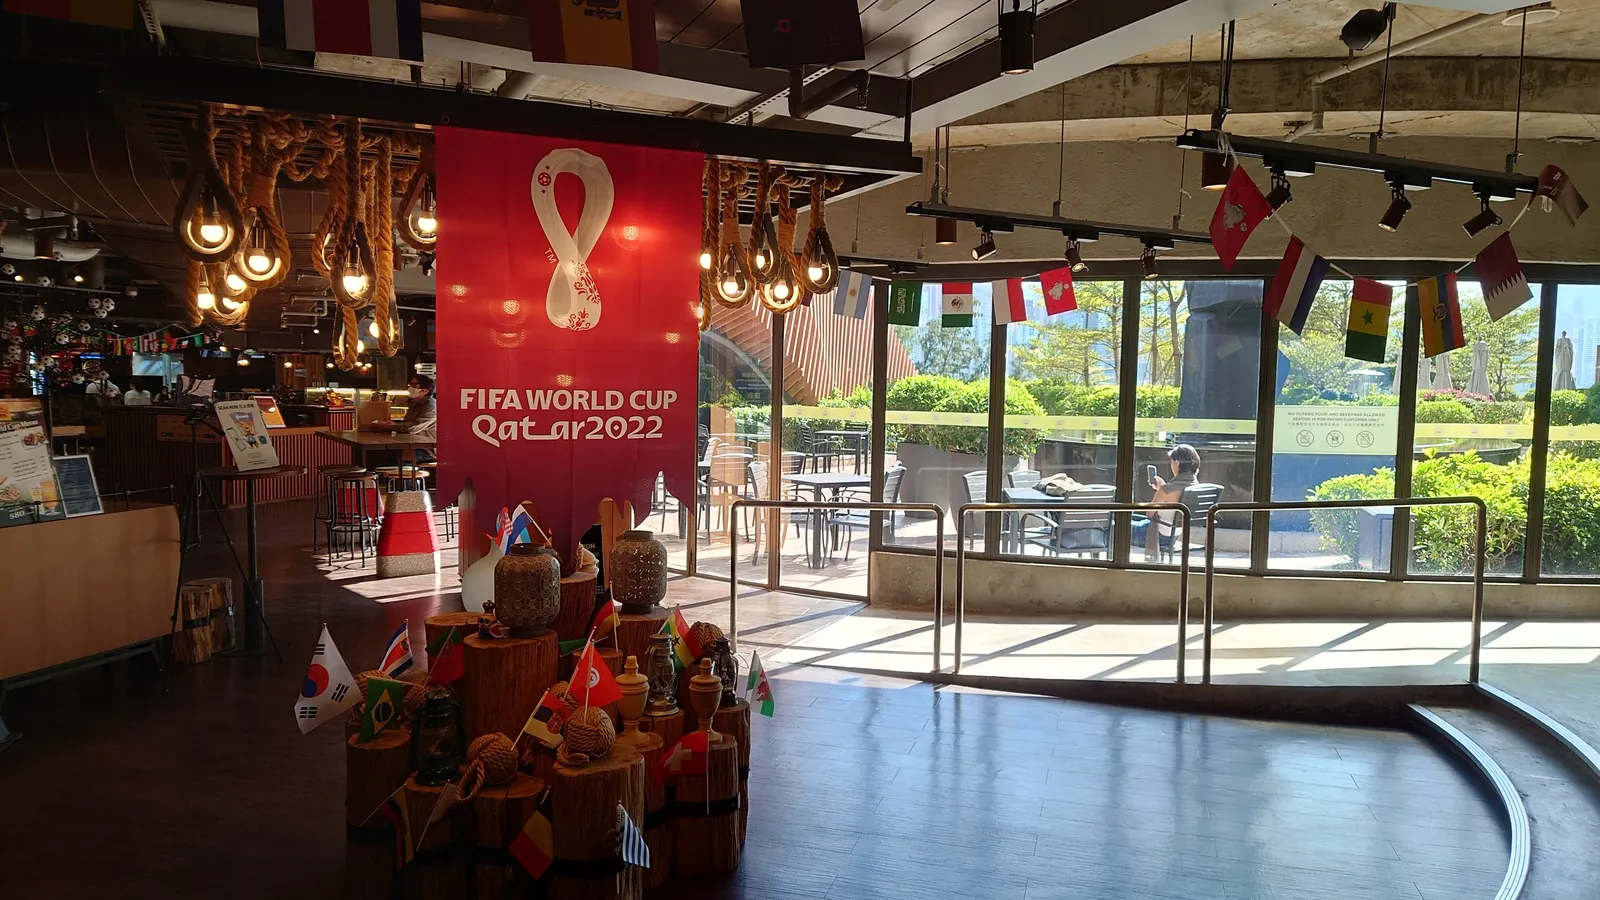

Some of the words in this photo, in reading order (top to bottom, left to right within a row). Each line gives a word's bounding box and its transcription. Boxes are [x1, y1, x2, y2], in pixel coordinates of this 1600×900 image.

[544, 247, 557, 264] TM
[460, 388, 523, 410] FIFA
[525, 389, 624, 411] WORLD
[629, 390, 678, 411] CUP
